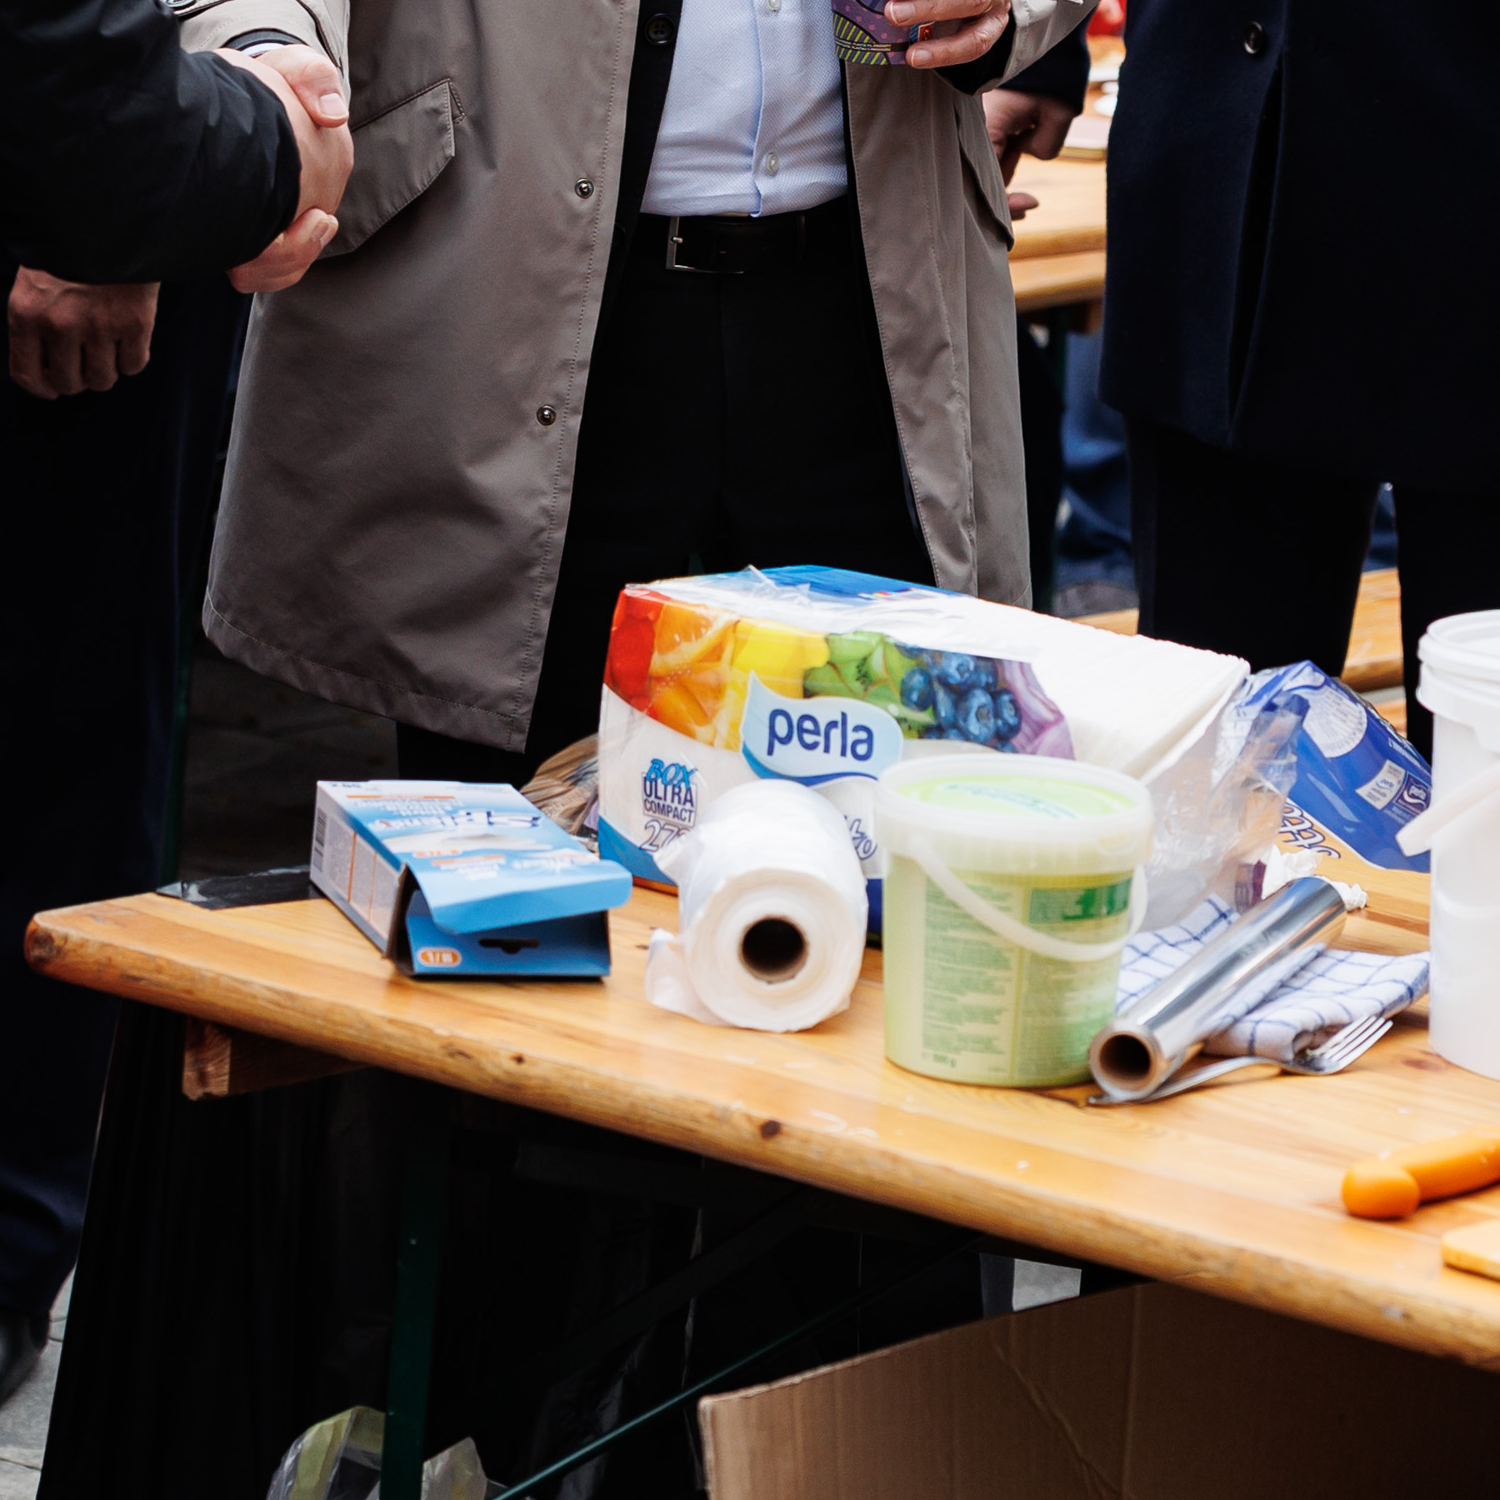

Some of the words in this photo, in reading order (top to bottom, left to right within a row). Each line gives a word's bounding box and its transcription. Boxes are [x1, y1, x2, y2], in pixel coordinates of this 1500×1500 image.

[766, 707, 875, 762] perla
[646, 758, 698, 790] BOX
[643, 775, 694, 808] ULTRA
[643, 798, 694, 823] COMPACT
[638, 819, 691, 852] 27
